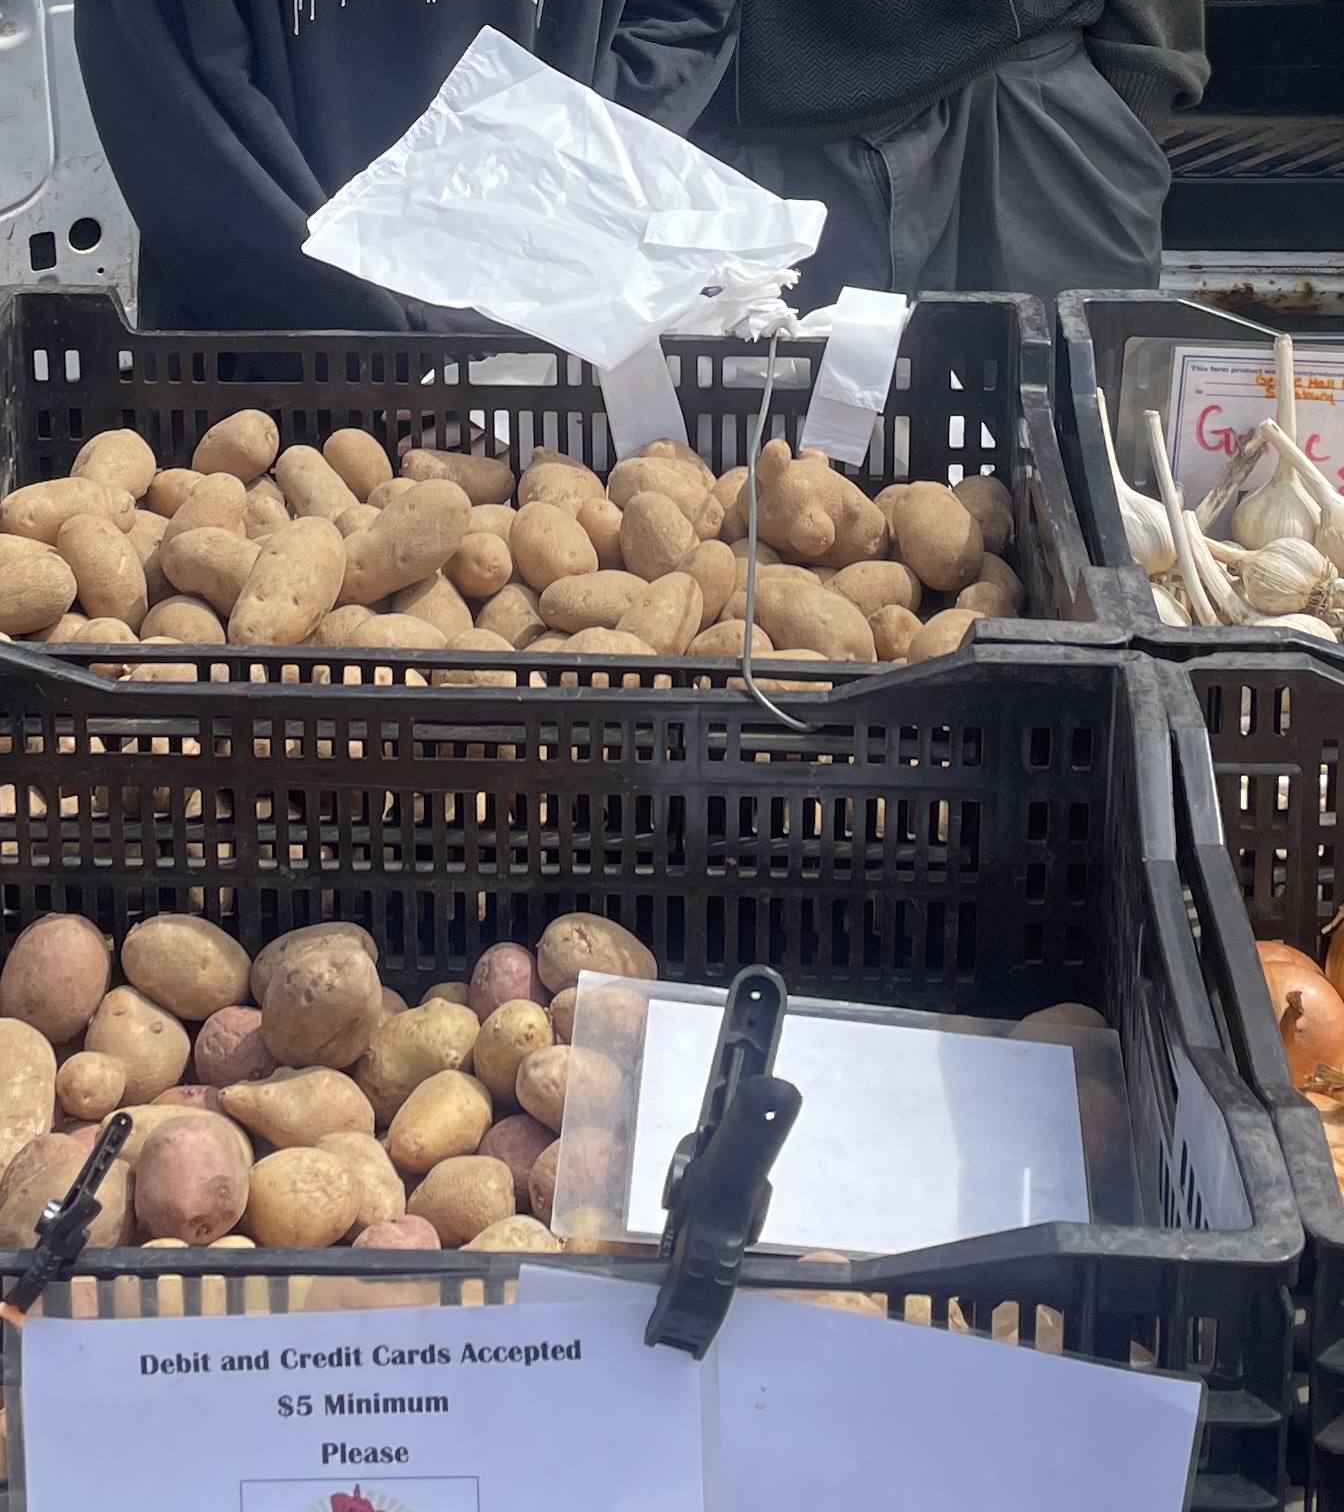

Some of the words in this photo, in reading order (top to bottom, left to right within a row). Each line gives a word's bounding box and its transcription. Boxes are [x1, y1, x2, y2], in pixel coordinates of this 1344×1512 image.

[1190, 364, 1208, 372] This
[1230, 368, 1263, 376] product
[140, 1351, 211, 1376] Debit
[220, 1349, 270, 1372] and
[280, 1346, 364, 1370] Credit
[372, 1343, 452, 1367] Cards
[460, 1339, 582, 1367] Accepted
[277, 1394, 313, 1420] $5
[324, 1392, 449, 1417] Minimum
[321, 1442, 410, 1465] Please
